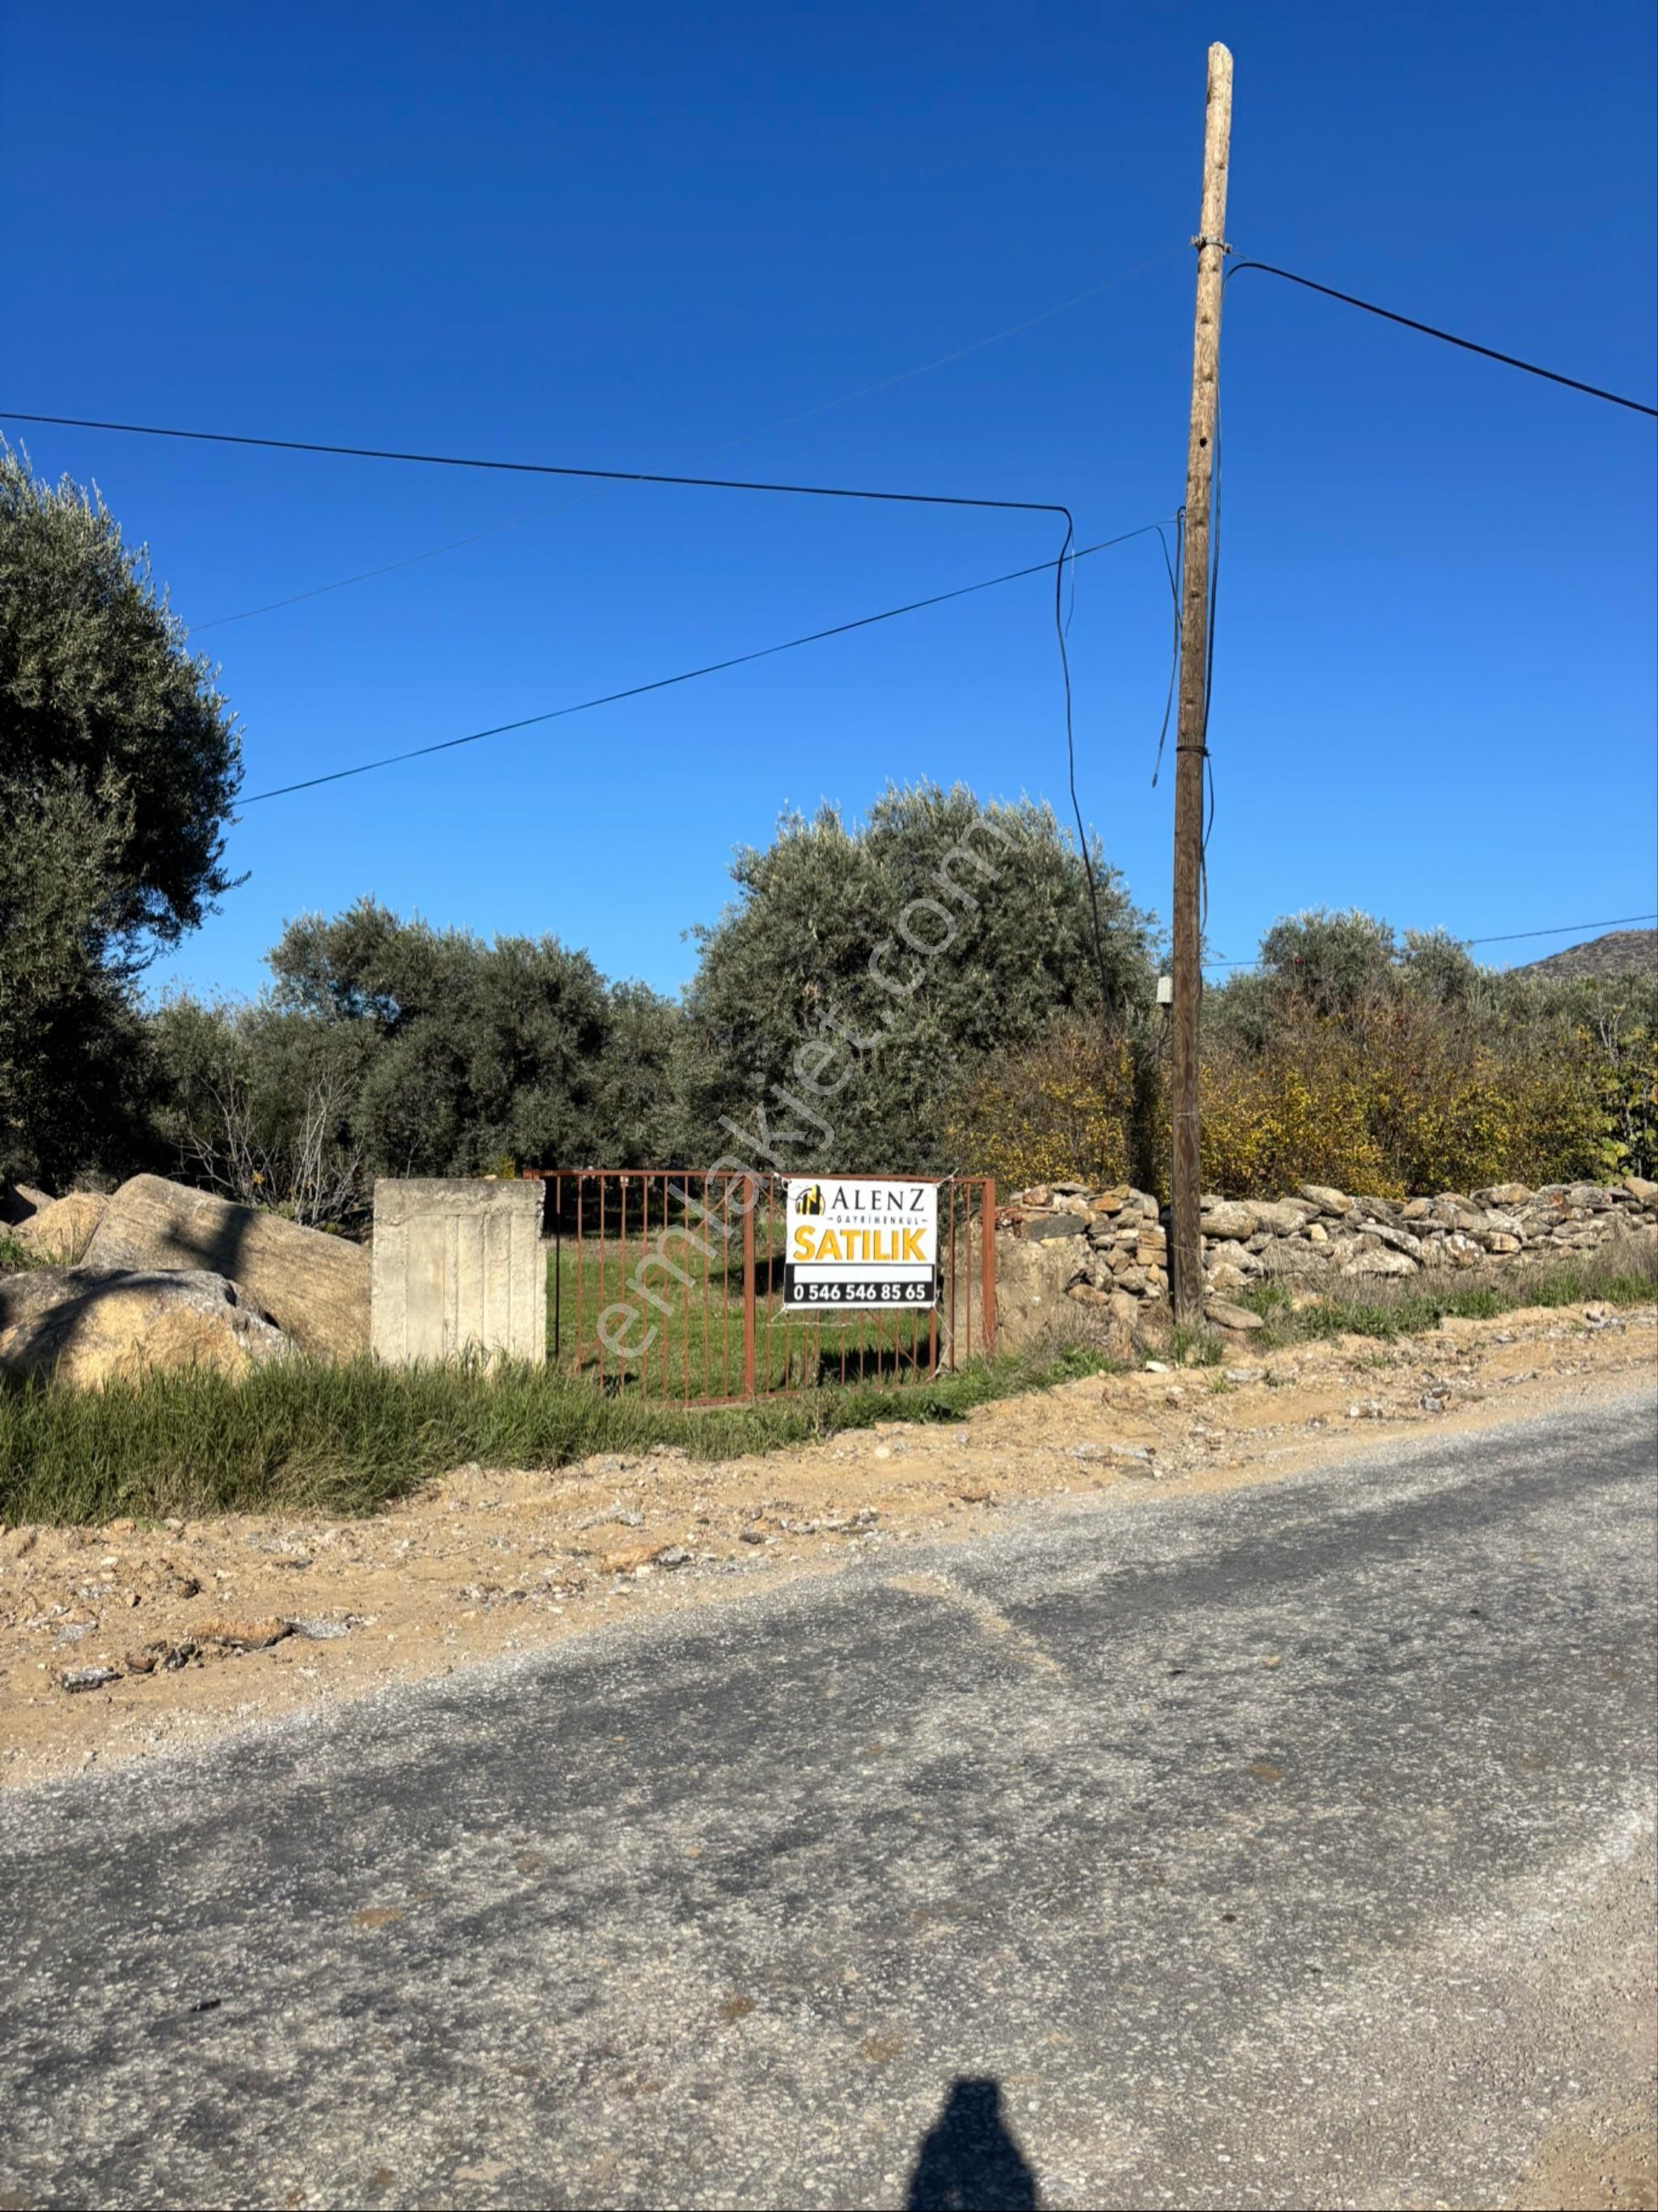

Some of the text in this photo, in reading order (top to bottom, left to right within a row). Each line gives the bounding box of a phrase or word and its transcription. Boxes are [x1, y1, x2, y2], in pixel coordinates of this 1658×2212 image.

[831, 1185, 925, 1212] ALENZ
[837, 1215, 918, 1225] GAYRİMENKUL
[792, 1225, 927, 1261] SATILIK
[793, 1284, 926, 1300] 0 546 546 85 65
